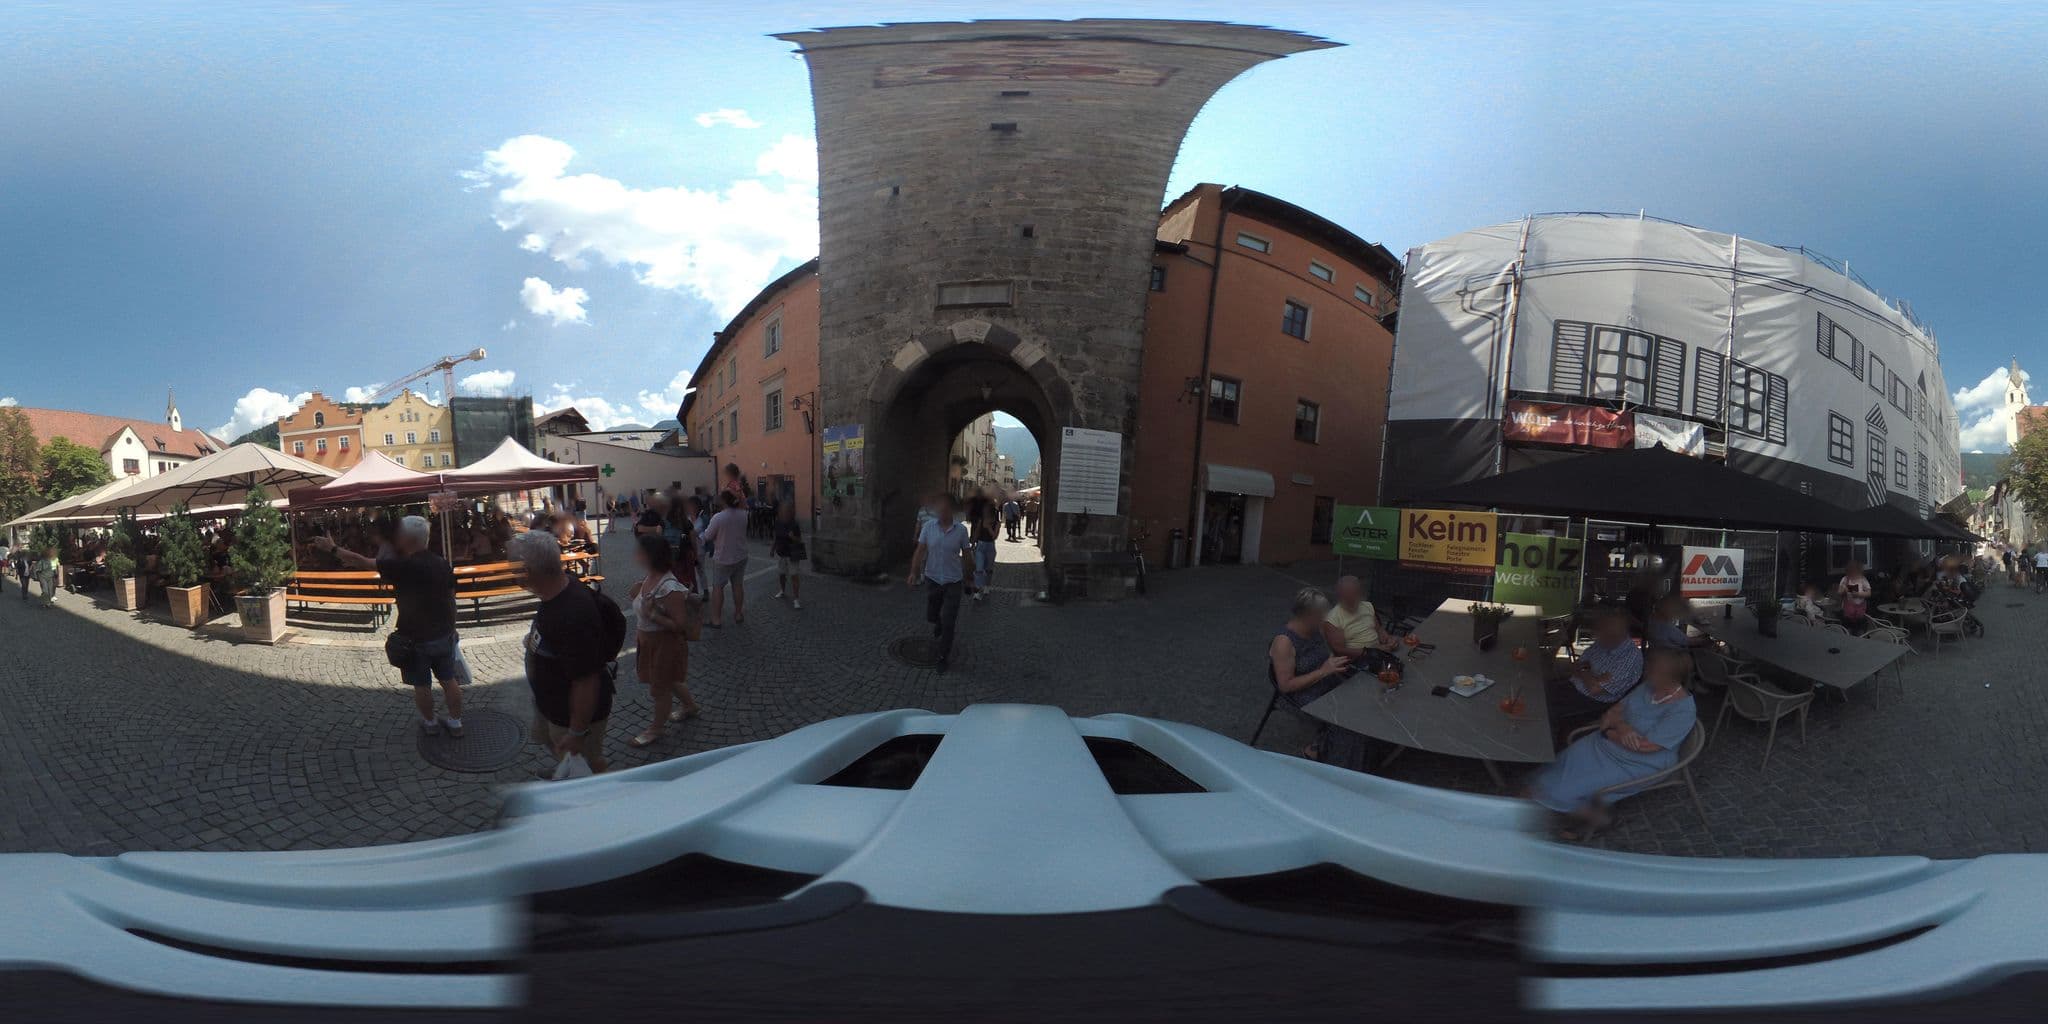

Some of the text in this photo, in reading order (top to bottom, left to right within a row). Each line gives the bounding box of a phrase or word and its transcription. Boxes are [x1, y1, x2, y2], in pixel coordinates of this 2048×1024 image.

[1511, 411, 1558, 427] WOLF
[1343, 526, 1388, 539] ASTER
[1408, 512, 1487, 543] Keim
[1496, 535, 1579, 571] holz
[1682, 577, 1739, 585] MALTECHBAU
